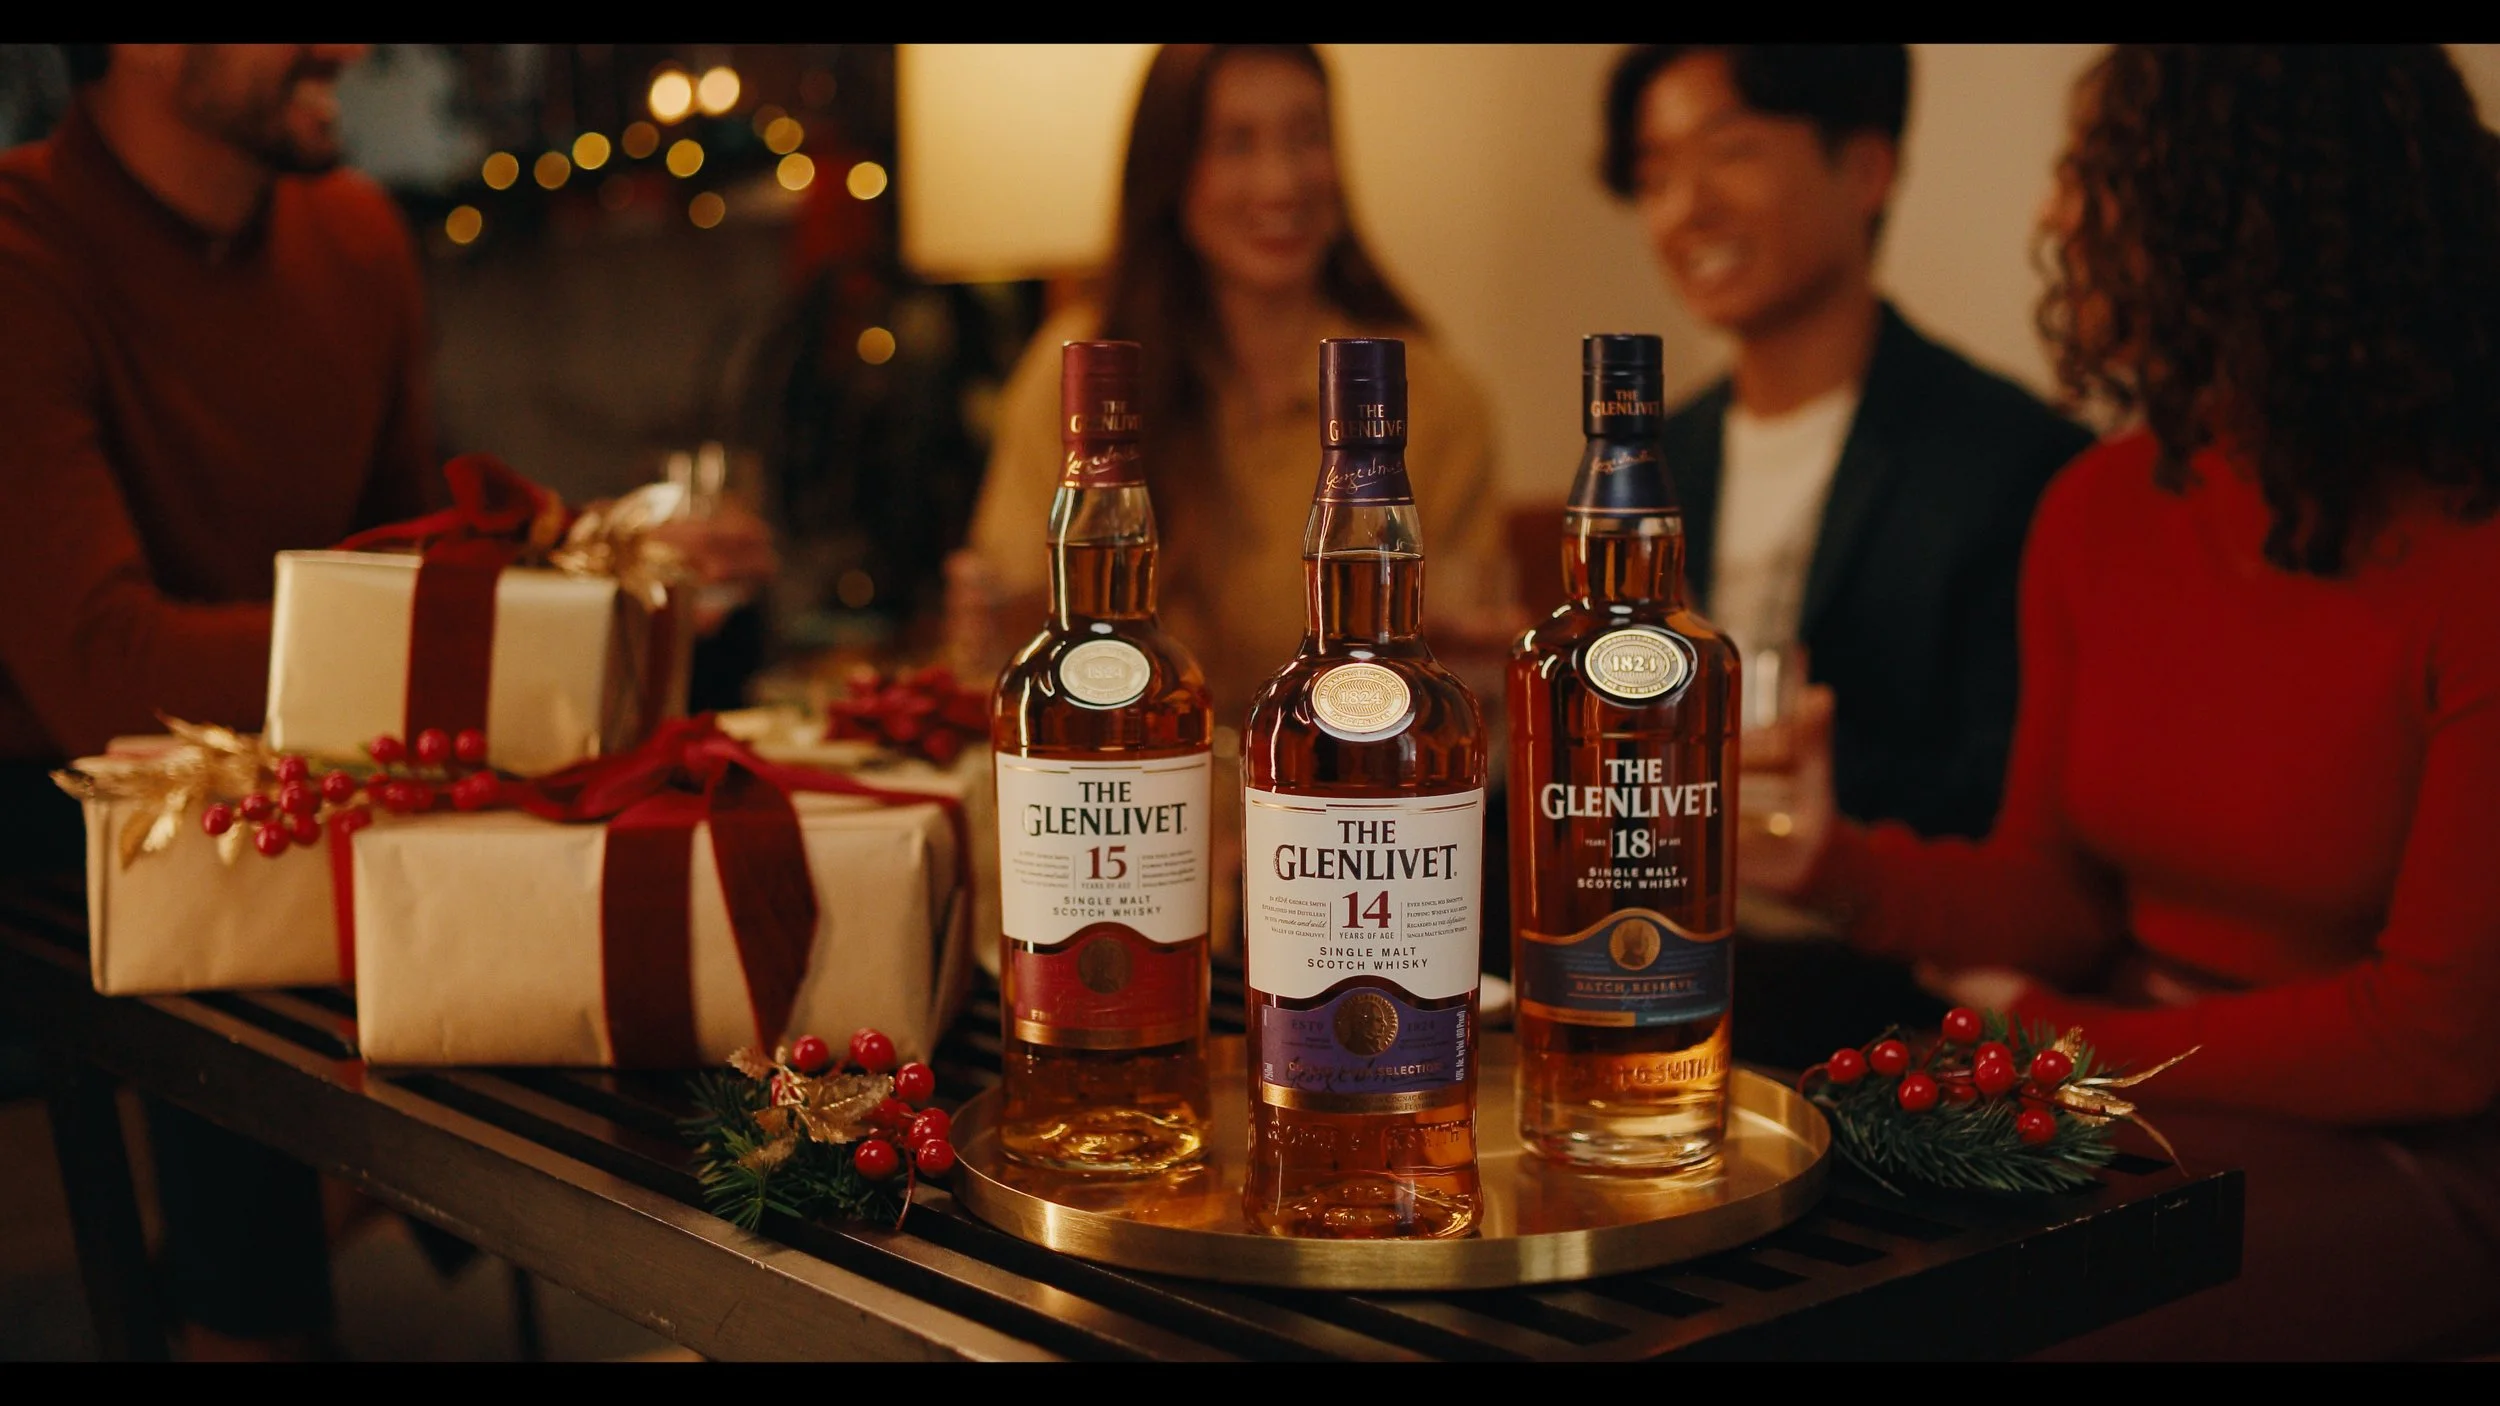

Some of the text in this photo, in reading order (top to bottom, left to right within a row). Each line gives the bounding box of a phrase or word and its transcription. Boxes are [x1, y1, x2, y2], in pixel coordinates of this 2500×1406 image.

[1616, 390, 1639, 400] THE
[1358, 404, 1384, 418] THE
[1340, 691, 1383, 705] 1824
[1604, 758, 1663, 784] THE
[1078, 781, 1132, 803] THE
[1337, 820, 1396, 844] THE
[1615, 828, 1651, 858] 18
[1086, 845, 1127, 880] 15
[1589, 866, 1678, 878] SINGLE MALT
[1081, 882, 1104, 890] YEARS
[1107, 882, 1115, 890] OF
[1577, 878, 1688, 889] SCOTCH WHISKY
[1064, 895, 1151, 906] SINGLE MALT
[1053, 906, 1162, 917] SCOTCH WHISKY
[1342, 890, 1392, 929] 14
[1339, 931, 1395, 940] YEARS OF AGE
[1320, 946, 1417, 958] SINGLE MALT
[1307, 958, 1428, 970] SCOTCH WHISKY
[1576, 981, 1625, 993] BATCH
